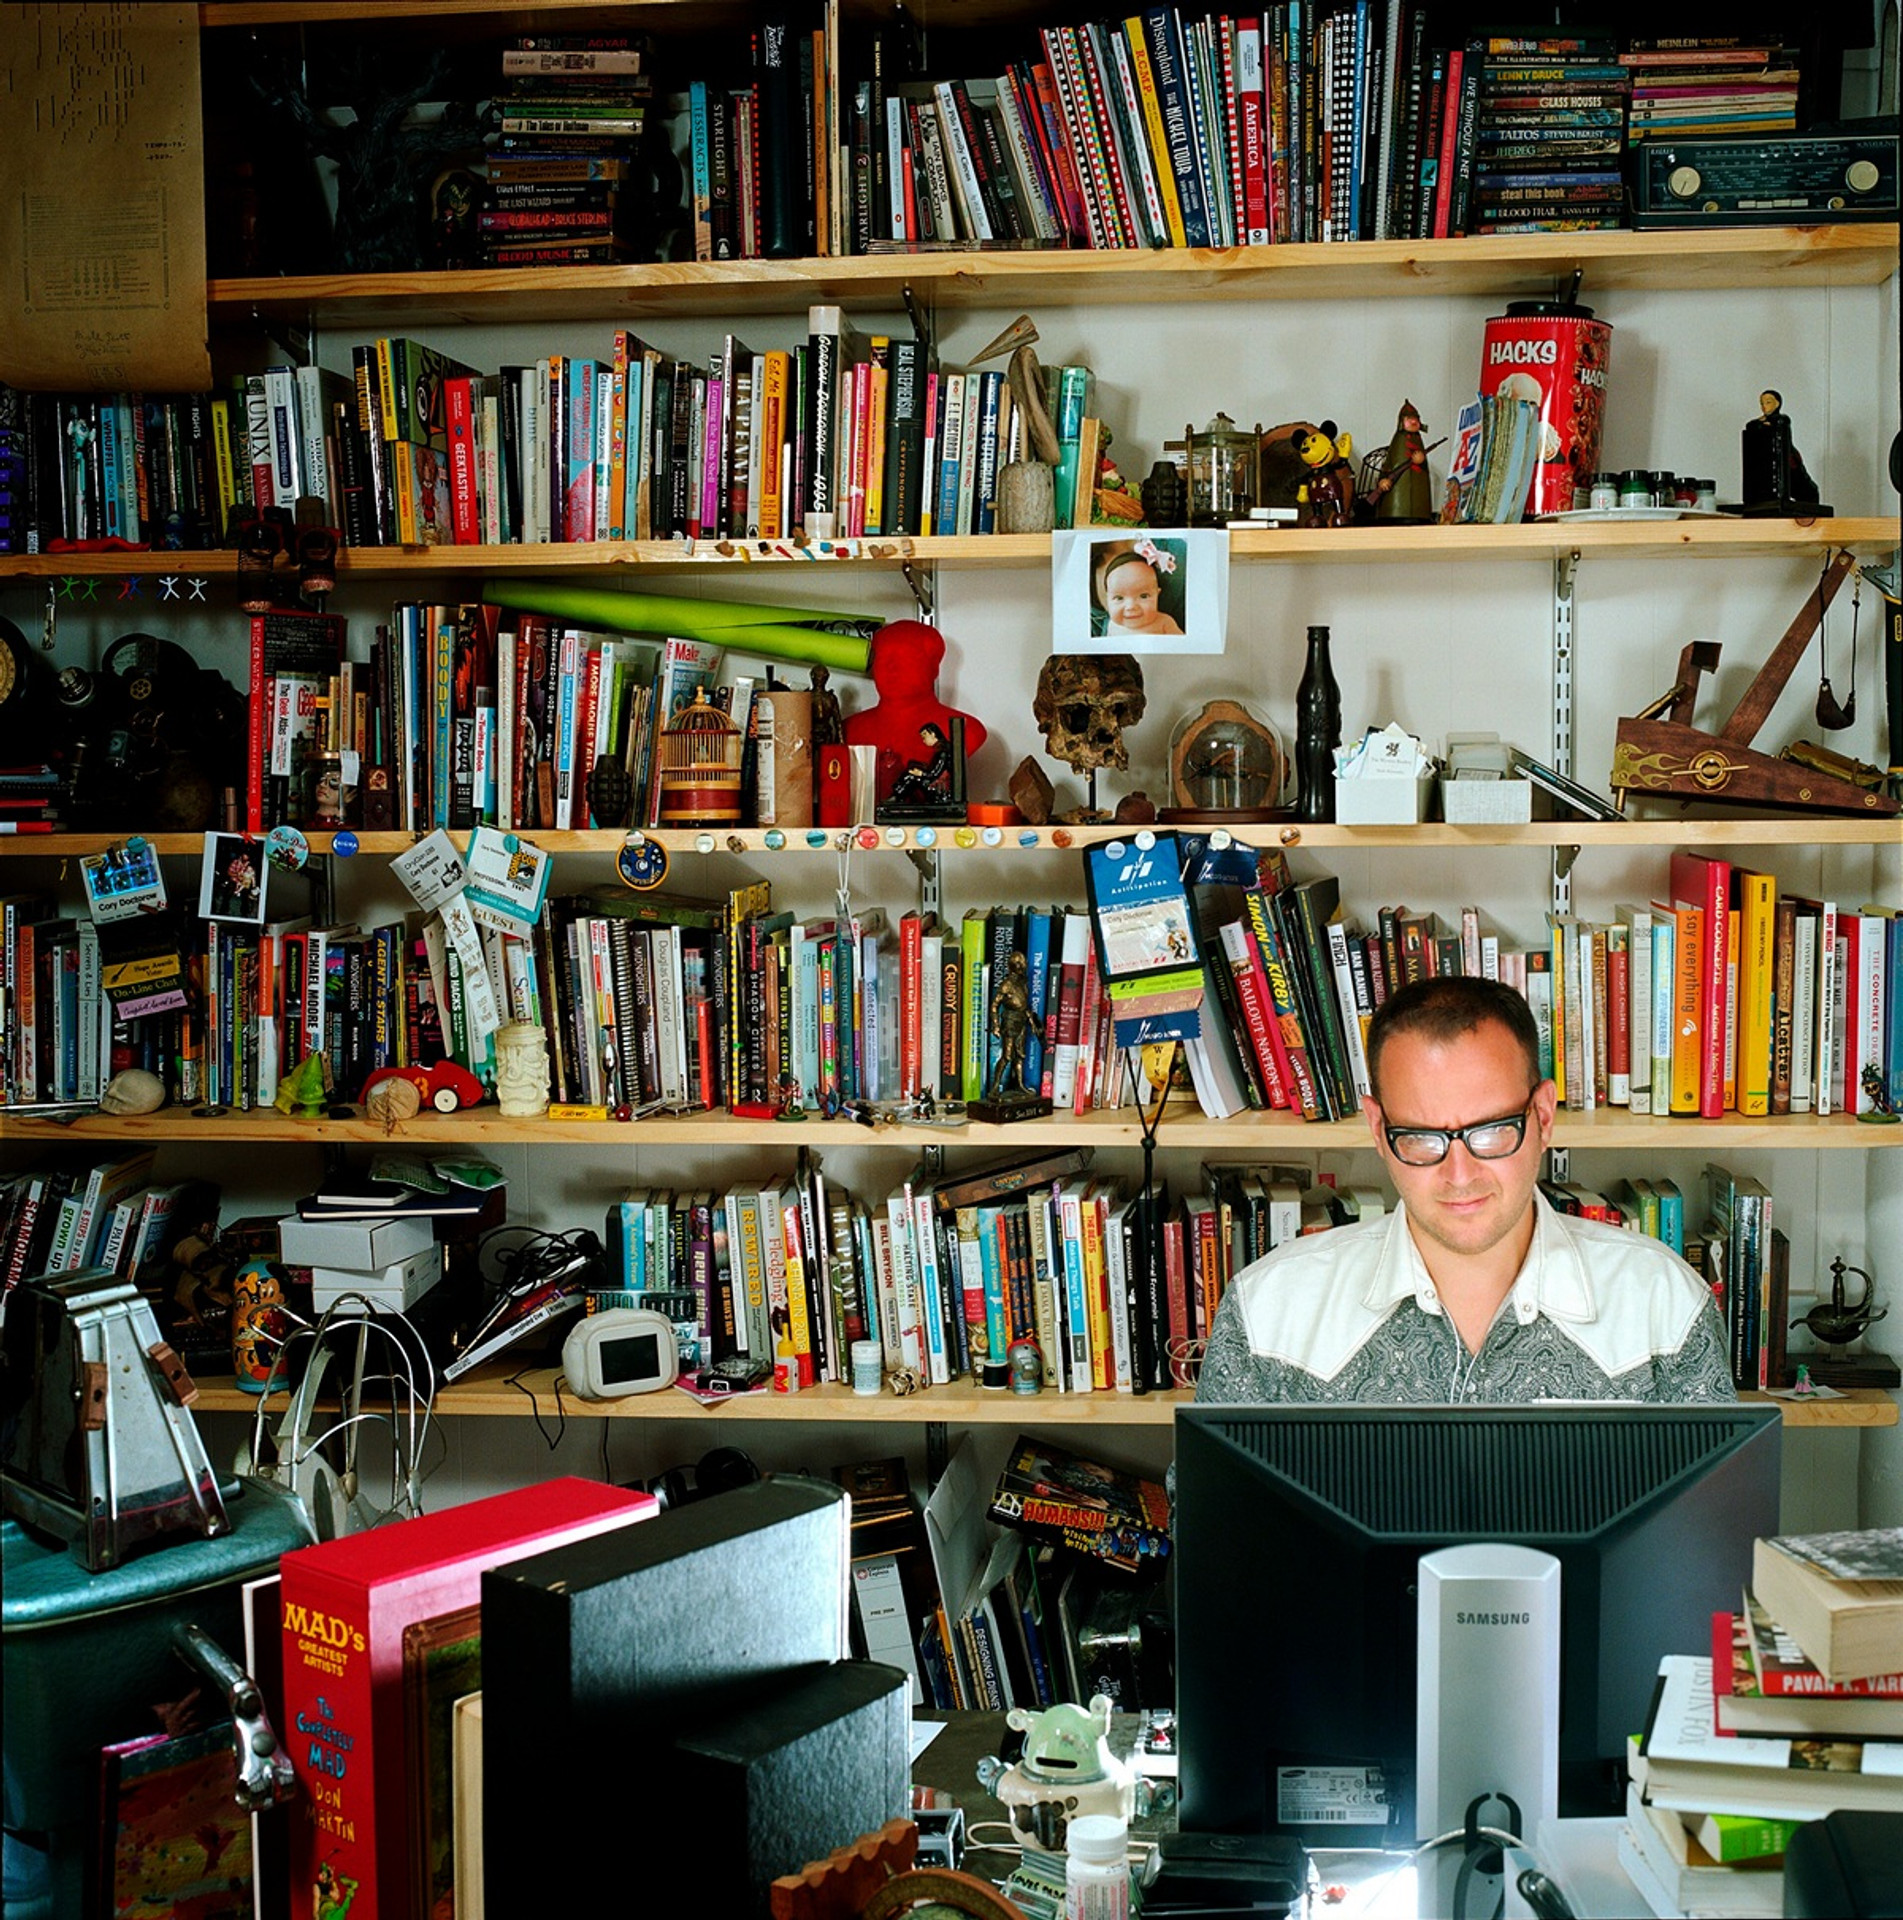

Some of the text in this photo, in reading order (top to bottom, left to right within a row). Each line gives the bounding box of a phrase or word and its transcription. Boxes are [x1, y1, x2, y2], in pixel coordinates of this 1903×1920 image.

[1136, 50, 1153, 97] R.C.M.P.
[1150, 14, 1177, 85] Disneyland
[1497, 69, 1564, 80] LENNY BRUCE
[1167, 106, 1188, 143] NICKEL
[1460, 77, 1476, 179] LIVE WITHOUT A NET
[1540, 97, 1602, 108] GLASS HOUSES
[715, 104, 726, 179] STARLIGHT
[944, 93, 953, 105] The
[951, 128, 965, 154] Family
[958, 157, 972, 182] Circus
[1176, 145, 1193, 176] TOUR
[1246, 101, 1259, 168] AMERICA
[1499, 130, 1539, 140] TALTOS
[1543, 131, 1576, 140] STEVEN
[927, 156, 944, 220] COMPLICITY
[933, 141, 948, 203] IAIN BANKS
[1018, 131, 1044, 201] COPYRIGHT
[1501, 188, 1565, 199] steal this book
[859, 174, 869, 250] STARLIGHT
[818, 335, 831, 384] GORDON
[1490, 340, 1557, 365] HACKS
[356, 366, 370, 431] WATCHMEN
[710, 384, 719, 422] Learning
[898, 345, 914, 419] NEAL STEPHENSON
[105, 421, 114, 467] WHUFFIE
[250, 400, 271, 458] UNIX
[278, 409, 286, 440] Information
[735, 379, 751, 483] HA'PENNY
[947, 418, 958, 459] DOCTOROW
[280, 441, 288, 473] Technology
[456, 443, 468, 500] GEEKTASTIC
[898, 439, 906, 523] CRYPTONOMICON
[253, 621, 263, 660] STICKER
[252, 661, 261, 694] NATION
[590, 664, 599, 697] MORE
[280, 683, 290, 736] The Geek Atlas
[588, 699, 597, 737] MOUSE
[98, 893, 157, 912] Cory Doctorow
[1111, 879, 1168, 894] Anticipation
[85, 943, 93, 971] Secrets
[994, 926, 1004, 988] ROBINSON
[1246, 893, 1290, 1009] SIMON AND KIRBY
[1331, 934, 1347, 967] FINCH
[1714, 885, 1724, 985] CARD CONCEPTS
[1825, 913, 1834, 952] DOPE MENACE
[309, 938, 320, 1028] MICHAEL MOORE
[351, 954, 360, 1011] MIDNIGHTERS
[377, 939, 386, 1043] AGENT STARS
[448, 952, 462, 1011] MIND HACKS
[634, 947, 646, 1005] MIDNIGHTERS
[659, 940, 671, 1022] Douglas Coupland
[944, 963, 958, 1011] CRUDDY
[1033, 952, 1042, 995] The Public
[1351, 950, 1371, 1010] IAN RANKIN
[1683, 915, 1700, 1013] say everything
[751, 973, 760, 1070] SHADOW CITIES
[868, 981, 877, 1029] Connected
[1239, 978, 1280, 1085] BAILOUT NATION
[781, 1036, 789, 1073] CHROME
[1778, 1010, 1789, 1082] Alcatraz
[5, 1202, 39, 1290] SCAMORAMA
[51, 1206, 74, 1270] grown up
[743, 1209, 762, 1308] REWIRED
[881, 1224, 893, 1289] BILL BRYSON
[769, 1237, 784, 1303] Fledgling
[904, 1244, 916, 1308] HALTING STATE
[1034, 1205, 1052, 1342] TERRITORY EMMA BULL
[1070, 1241, 1082, 1311] Making Things Talk
[791, 1259, 807, 1353] CHINA IN 2008
[1022, 1502, 1105, 1531] HUMANS!!!
[283, 1601, 366, 1653] MAD's
[1456, 1612, 1530, 1625] SAMSUNG
[298, 1639, 349, 1666] GREATEST
[303, 1653, 345, 1677] ARTISTS
[975, 1627, 995, 1680] DESIGNING
[1868, 1676, 1903, 1692] VAR
[307, 1742, 346, 1780] MAD
[316, 1781, 341, 1809] DON
[306, 1804, 355, 1843] MARTIN
